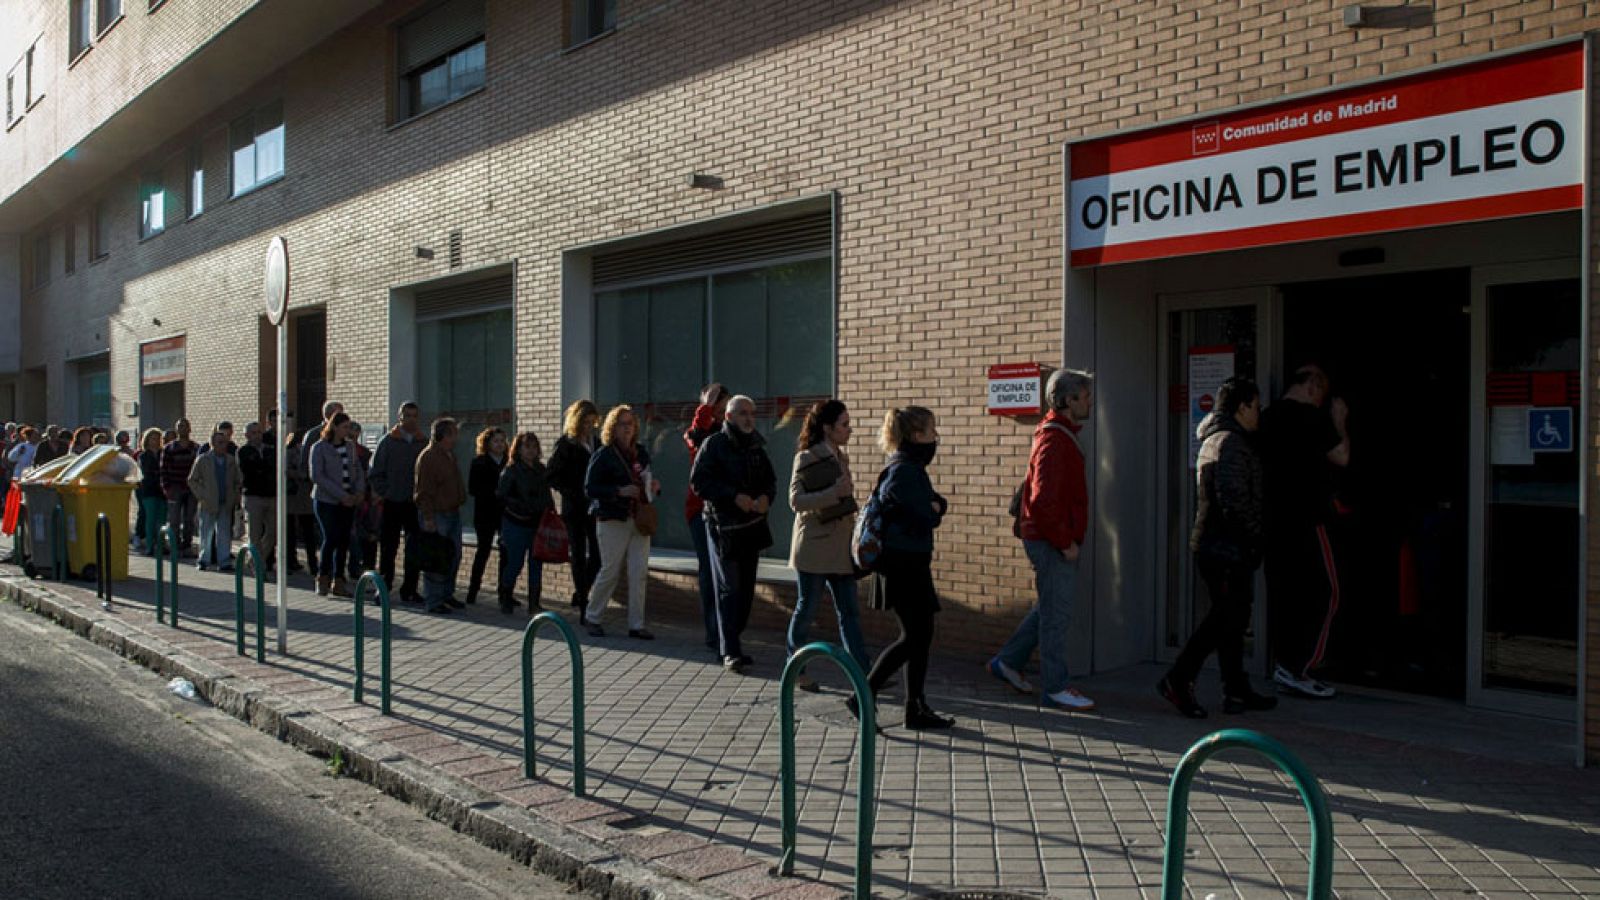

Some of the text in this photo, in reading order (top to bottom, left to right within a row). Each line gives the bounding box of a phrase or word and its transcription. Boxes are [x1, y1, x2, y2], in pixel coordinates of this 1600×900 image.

[1223, 94, 1397, 140] Comunidad de Madrid
[1081, 118, 1566, 231] OFICINA DE EMPLEO
[991, 382, 1036, 393] OFICINA DE
[997, 393, 1031, 403] EMPLEO
